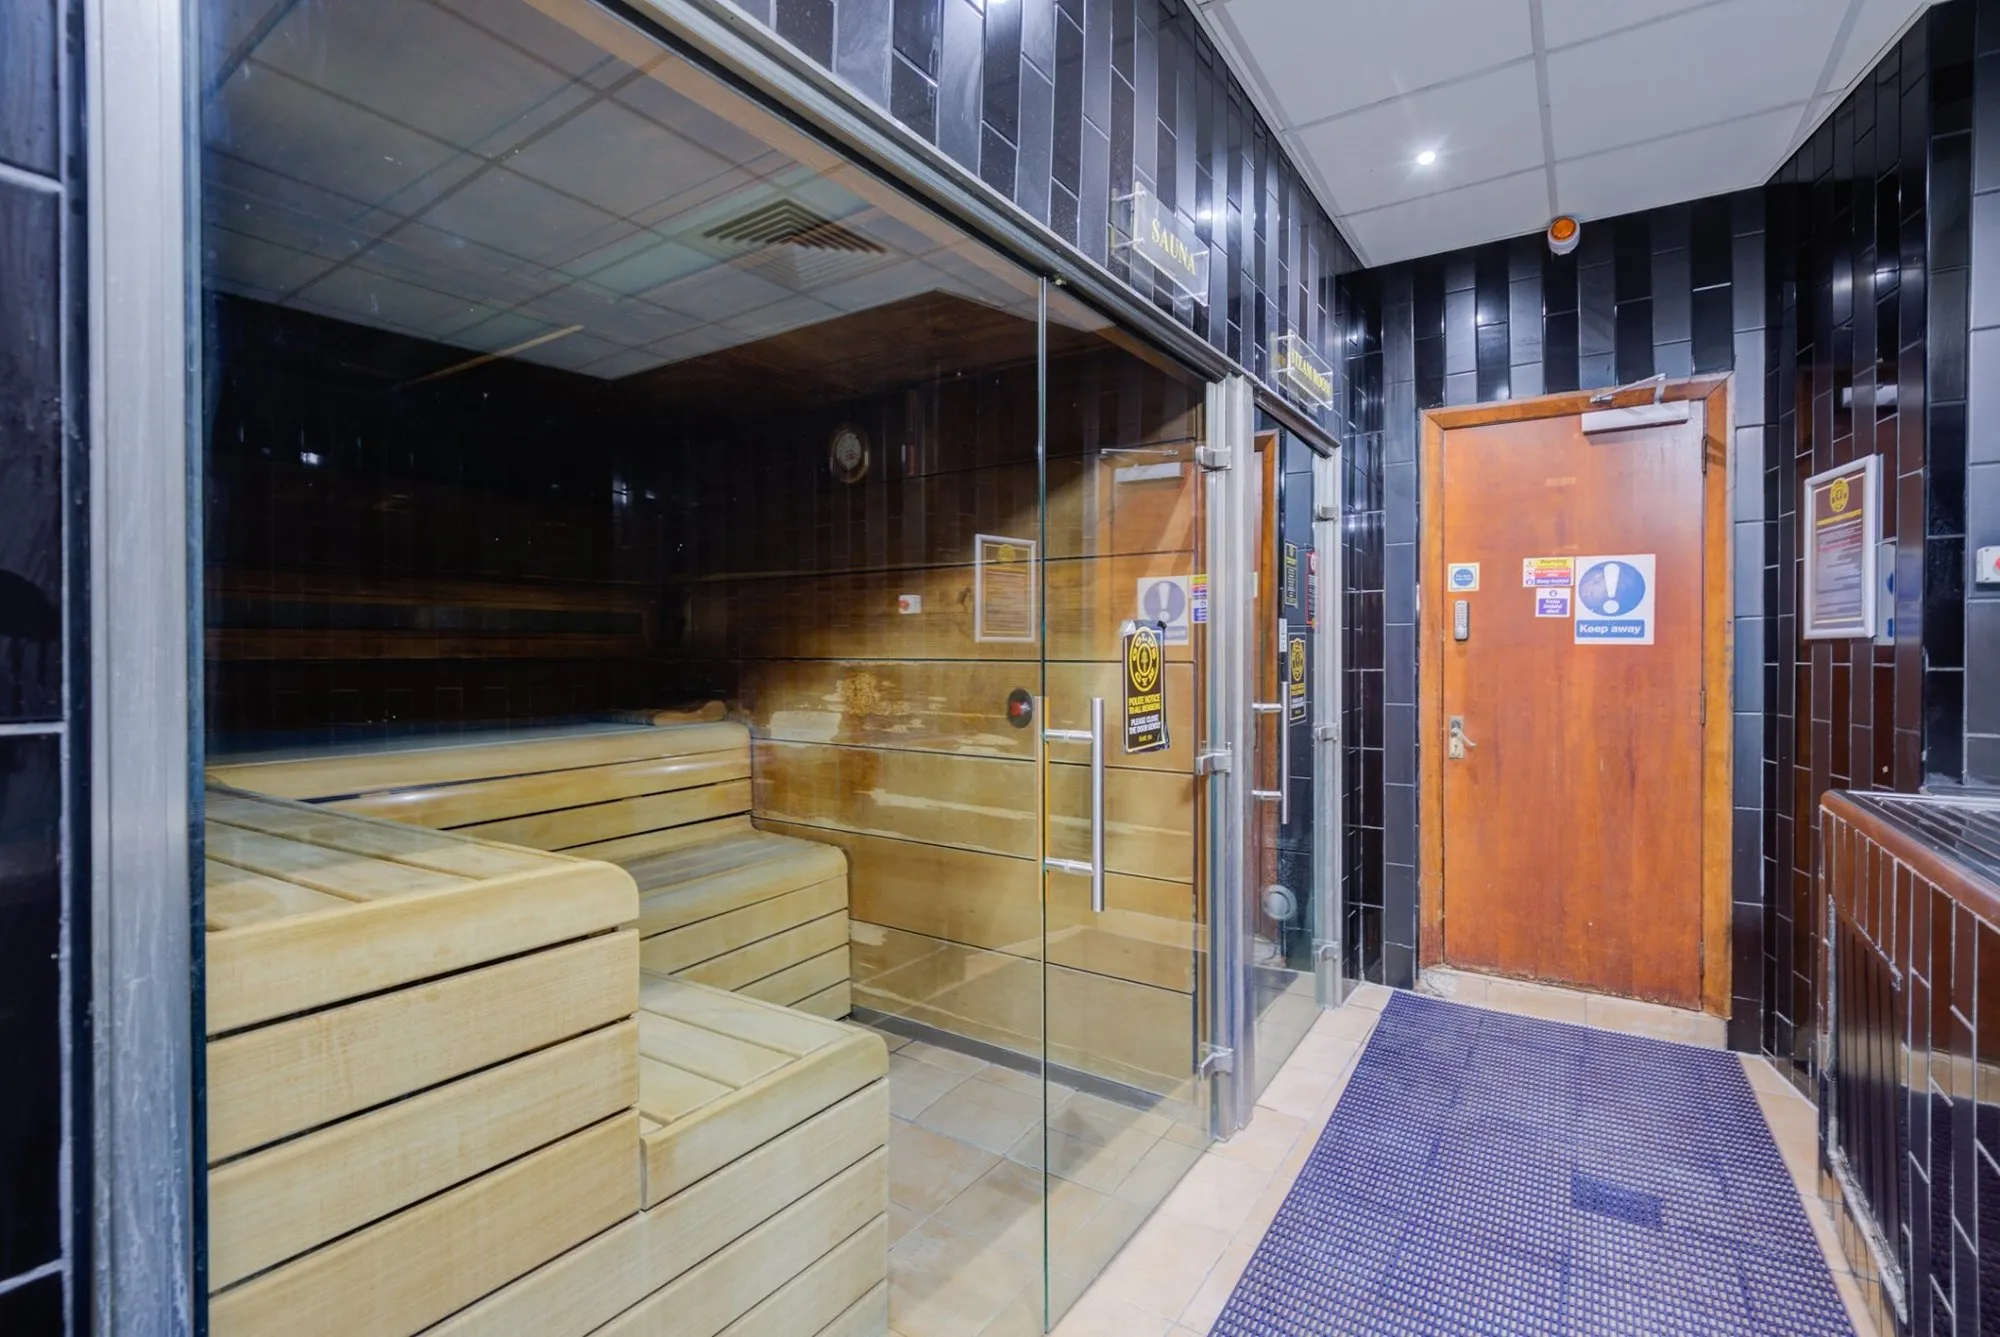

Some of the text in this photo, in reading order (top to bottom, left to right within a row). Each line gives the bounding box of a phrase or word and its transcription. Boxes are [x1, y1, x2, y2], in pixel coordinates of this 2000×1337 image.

[1151, 218, 1195, 276] SAUNA
[1579, 624, 1642, 635] Keep away
[1135, 667, 1156, 687] GYM
